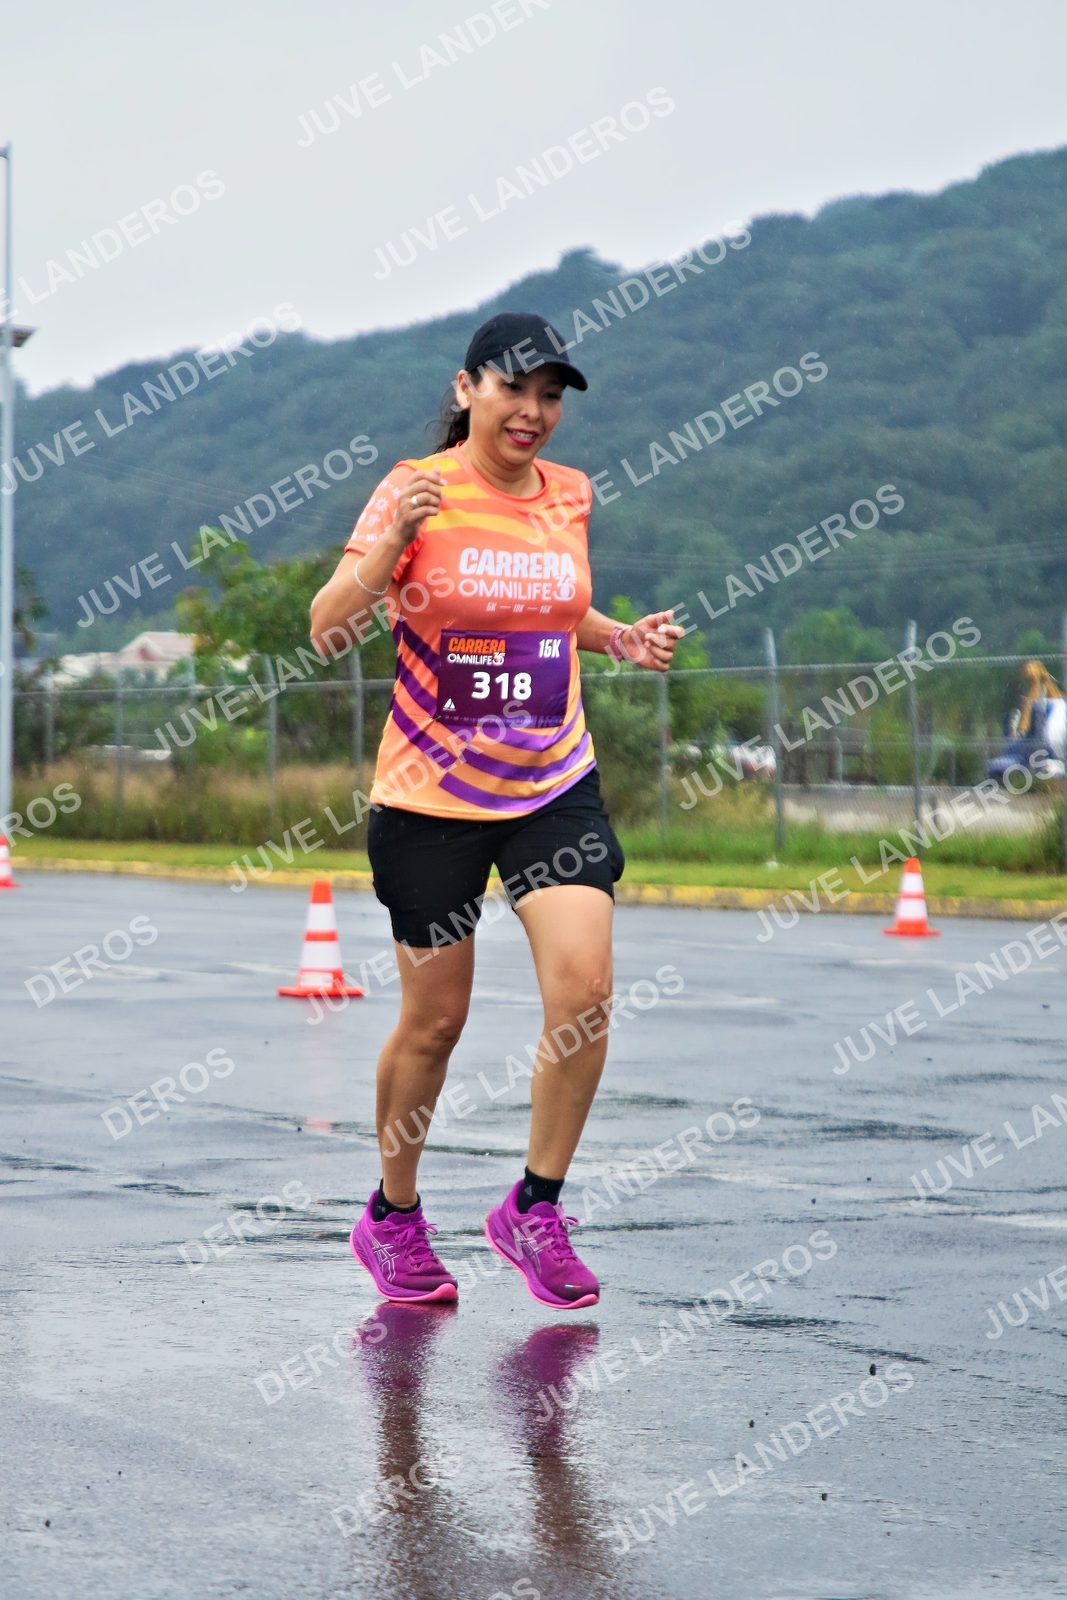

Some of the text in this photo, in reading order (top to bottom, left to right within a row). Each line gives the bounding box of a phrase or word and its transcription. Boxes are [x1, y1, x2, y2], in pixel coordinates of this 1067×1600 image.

[459, 548, 576, 581] CARRERA
[448, 637, 506, 653] CARRERA
[538, 639, 562, 659] 15K
[471, 671, 532, 700] 318
